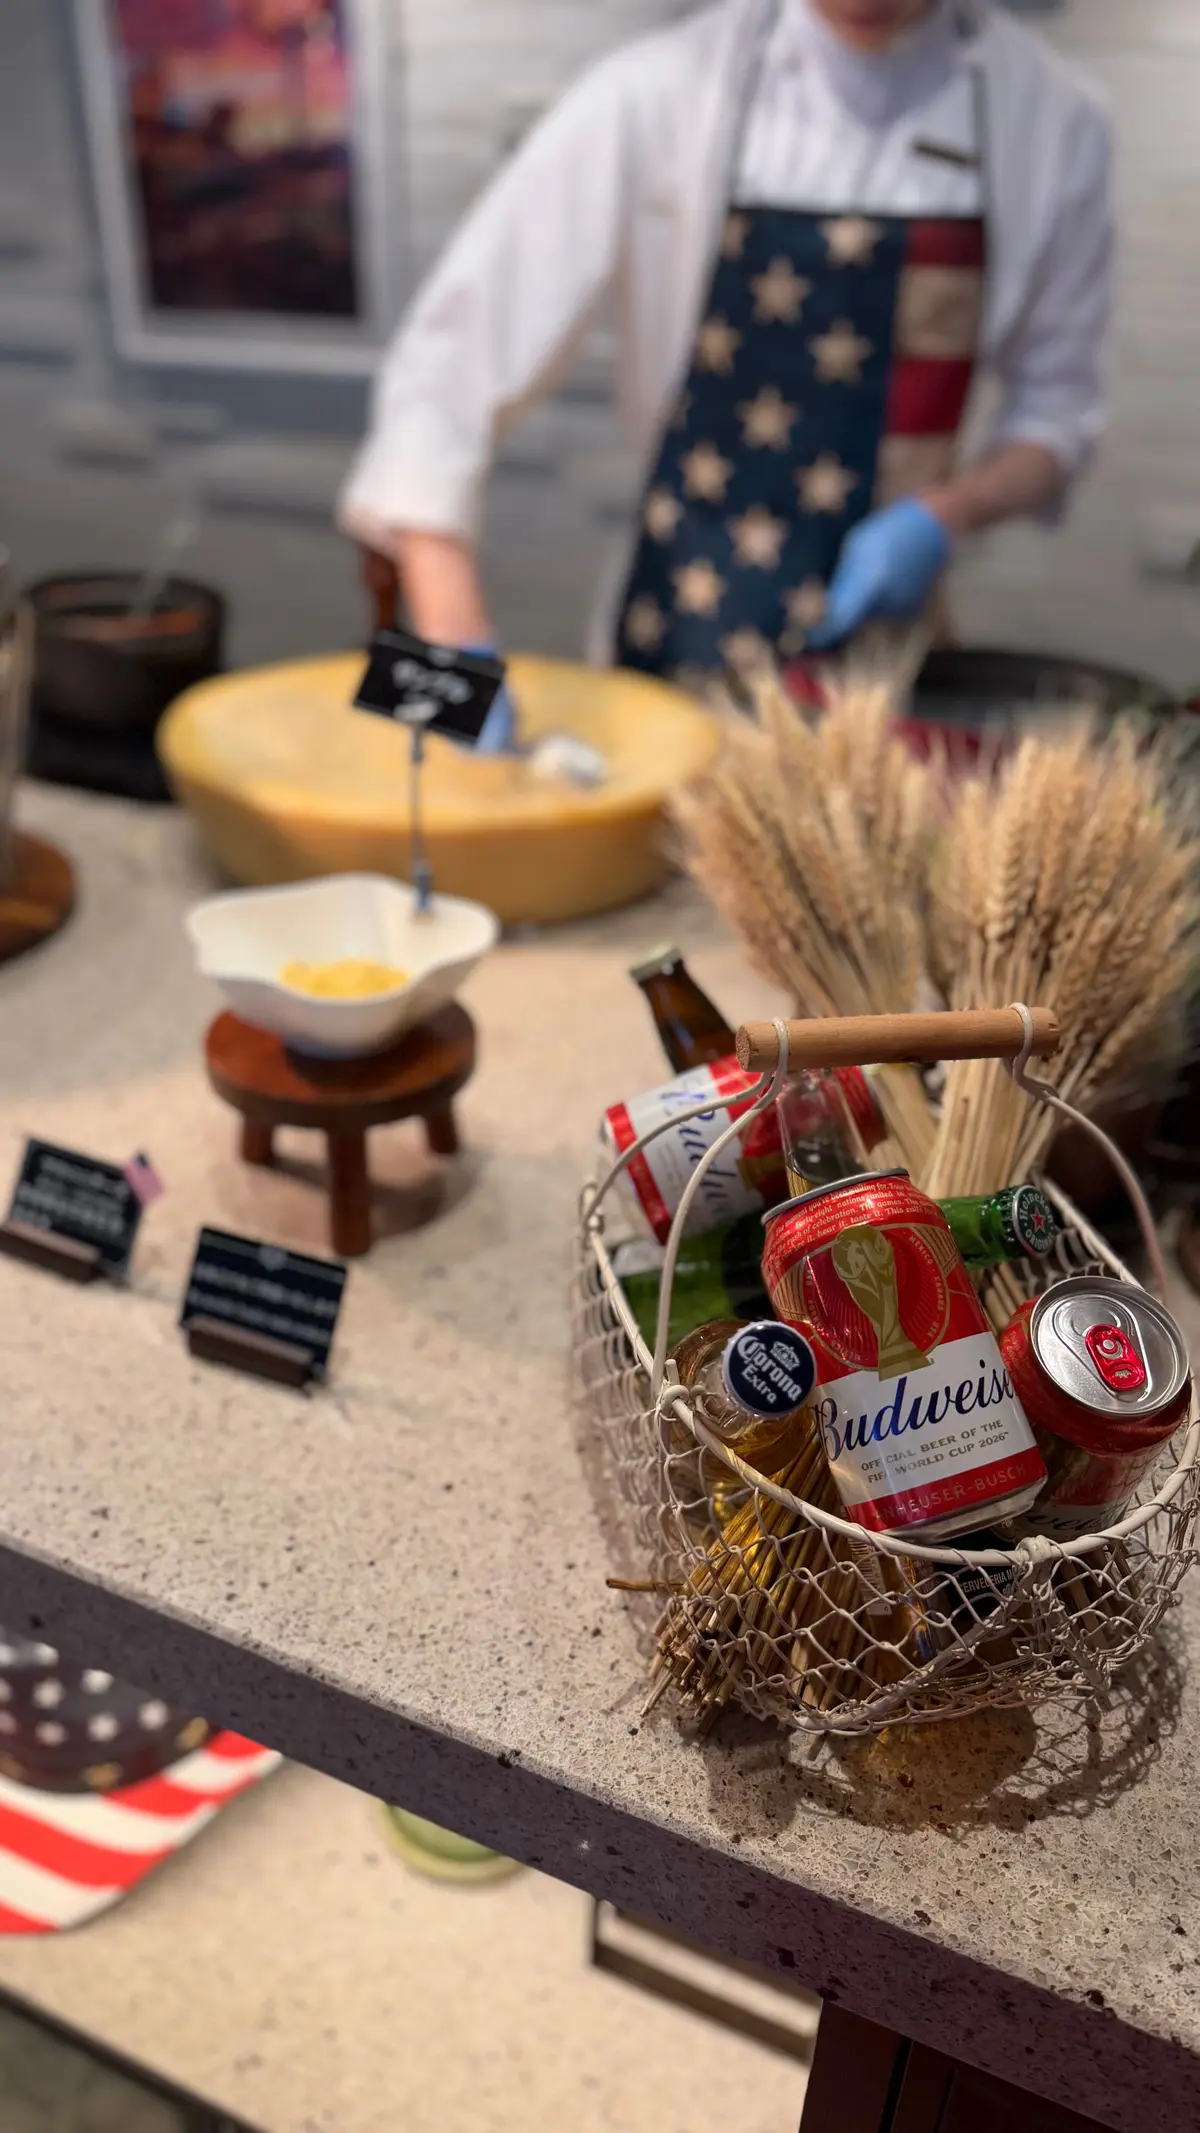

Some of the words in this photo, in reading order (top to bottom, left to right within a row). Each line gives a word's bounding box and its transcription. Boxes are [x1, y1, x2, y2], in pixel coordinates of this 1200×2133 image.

[795, 1204, 832, 1230] Forty-eight
[837, 1195, 866, 1209] nations
[870, 1190, 894, 1201] united
[808, 1196, 830, 1213] you've
[1019, 1193, 1053, 1223] Heineken
[803, 1224, 813, 1235] of
[812, 1207, 859, 1230] celebration.
[817, 1224, 836, 1238] hear
[850, 1213, 871, 1224] taste
[885, 1206, 904, 1215] This
[908, 1235, 933, 1264] MEXICO
[737, 1335, 802, 1402] Corona
[741, 1363, 777, 1404] Extra
[861, 1448, 918, 1472] OFFCIAL
[920, 1434, 957, 1453] BEER
[961, 1427, 978, 1440] OF
[980, 1419, 1004, 1433] THE
[894, 1453, 945, 1475] WORLD
[948, 1442, 975, 1459] CUP
